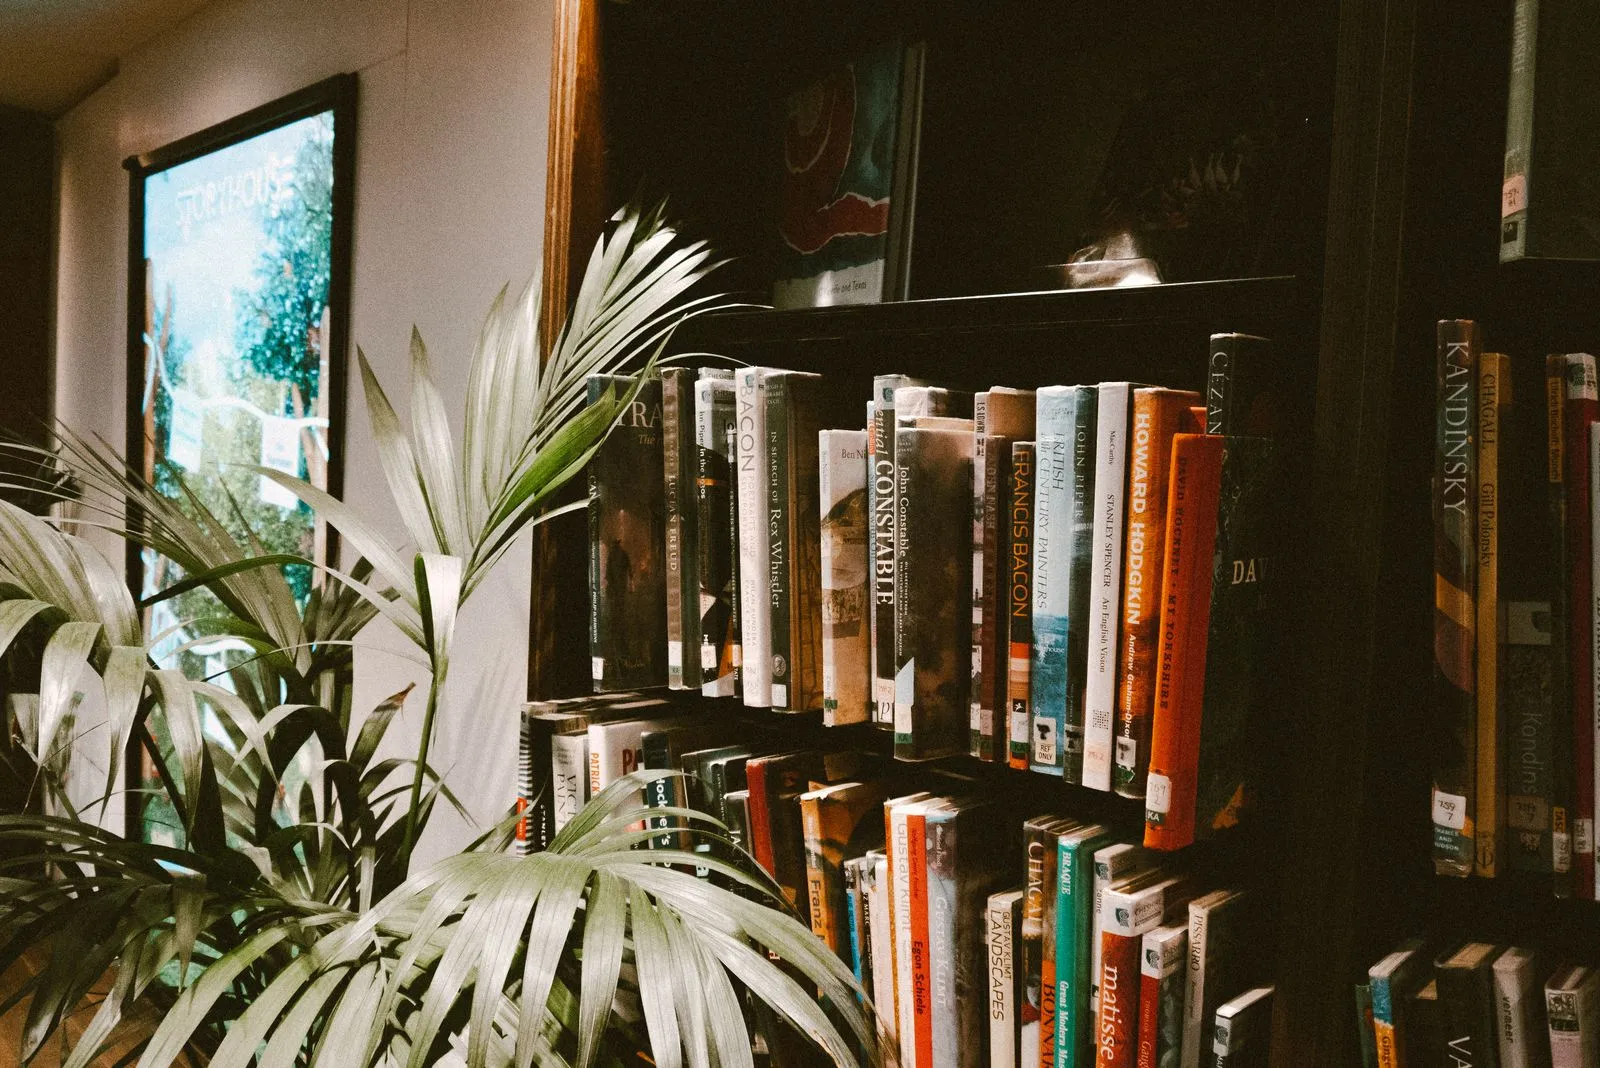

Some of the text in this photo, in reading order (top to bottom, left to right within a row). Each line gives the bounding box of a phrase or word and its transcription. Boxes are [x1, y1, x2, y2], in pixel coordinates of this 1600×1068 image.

[615, 399, 662, 428] RA
[1208, 351, 1229, 434] CÉZAN
[700, 448, 706, 456] in
[740, 386, 754, 472] BACON
[771, 431, 778, 443] IN
[842, 448, 855, 459] Ben
[1108, 430, 1116, 465] MacCarthy
[1444, 340, 1468, 515] KANDINSKY
[772, 490, 778, 503] OF
[898, 465, 910, 494] John
[1038, 458, 1050, 530] CENTURY
[1074, 424, 1086, 518] JOHN PIPER
[1480, 374, 1496, 568] CHAGALL Gill Polonsky
[668, 474, 677, 570] LUCIAN FREUD
[770, 508, 782, 536] Rex
[875, 410, 894, 604] ential CONSTABLE
[900, 498, 910, 557] Constable
[986, 496, 996, 529] NASH
[1012, 450, 1030, 617] FRANCIS BACON
[1127, 413, 1150, 625] HOWARD HODGKIN
[1170, 508, 1184, 576] HOCKNEY
[769, 540, 782, 608] Whistler
[1037, 536, 1048, 608] PAINTERS
[1099, 494, 1115, 673] STANLEY SPENCER An English Vision
[1166, 595, 1178, 618] MY
[1128, 634, 1136, 670] Andrew
[1160, 622, 1176, 710] YORKSHIRE
[590, 752, 600, 792] PATRICK
[1038, 752, 1052, 760] ONLY
[898, 824, 910, 883] Gustav
[1061, 851, 1071, 894] BRAQUE
[810, 880, 824, 928] Franz
[900, 888, 912, 932] Klimt
[990, 910, 1004, 1021] LANDSCAPES
[1002, 911, 1012, 980] GUSTAV KLIMT
[1190, 915, 1204, 971] PISSARRO
[912, 940, 926, 1015] Egon Schiele
[936, 958, 948, 1006] KLIMT
[1058, 980, 1070, 1068] Great Modern Mas
[1100, 964, 1122, 1060] matisse
[1448, 1036, 1472, 1068] VA
